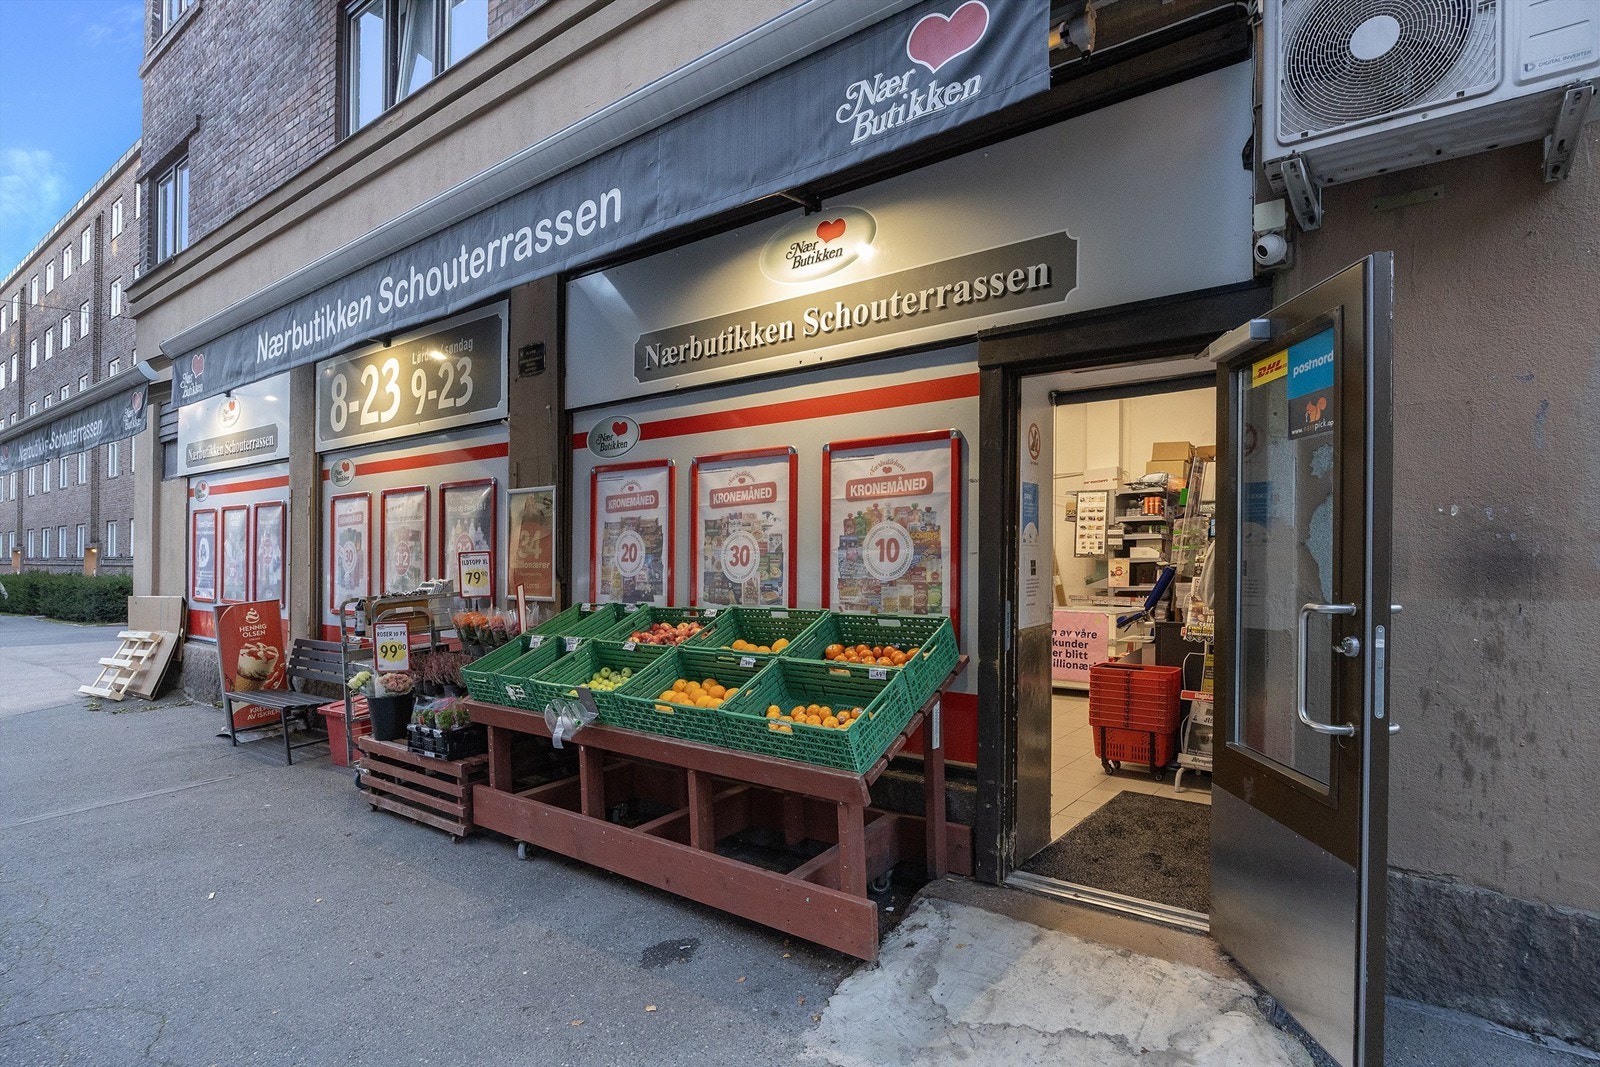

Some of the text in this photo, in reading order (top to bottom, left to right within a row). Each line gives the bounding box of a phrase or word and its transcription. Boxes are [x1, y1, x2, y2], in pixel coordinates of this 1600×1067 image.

[1538, 50, 1592, 67] DIGITAL INVERTER
[836, 69, 916, 124] Nær
[851, 74, 982, 145] Butikken
[785, 240, 819, 260] Nær
[791, 247, 843, 270] Butikken
[256, 186, 623, 365] Nærbutikken Schouterrassen
[644, 261, 1050, 370] Nærbutikken Schouterrassen
[444, 338, 473, 355] søndag
[1257, 360, 1282, 379] DHL
[1293, 350, 1334, 378] postnord
[330, 357, 401, 433] 8-23
[411, 356, 474, 416] 9-23
[225, 434, 275, 455] Schouterrassen
[596, 432, 614, 446] Nær
[600, 440, 628, 452] Butikken
[712, 486, 773, 504] KRONEMÅNED
[850, 476, 928, 497] KRONEMÅNED
[608, 494, 656, 510] KRONEMÅNED
[620, 542, 638, 563] 20
[729, 544, 751, 567] 30
[874, 537, 900, 563] 10
[465, 571, 481, 585] 79
[239, 623, 267, 632] HENNIG
[242, 630, 266, 638] OLSEN
[1075, 628, 1098, 639] våre
[380, 644, 398, 659] 99
[1052, 638, 1089, 649] kunder
[1065, 649, 1089, 660] blitt
